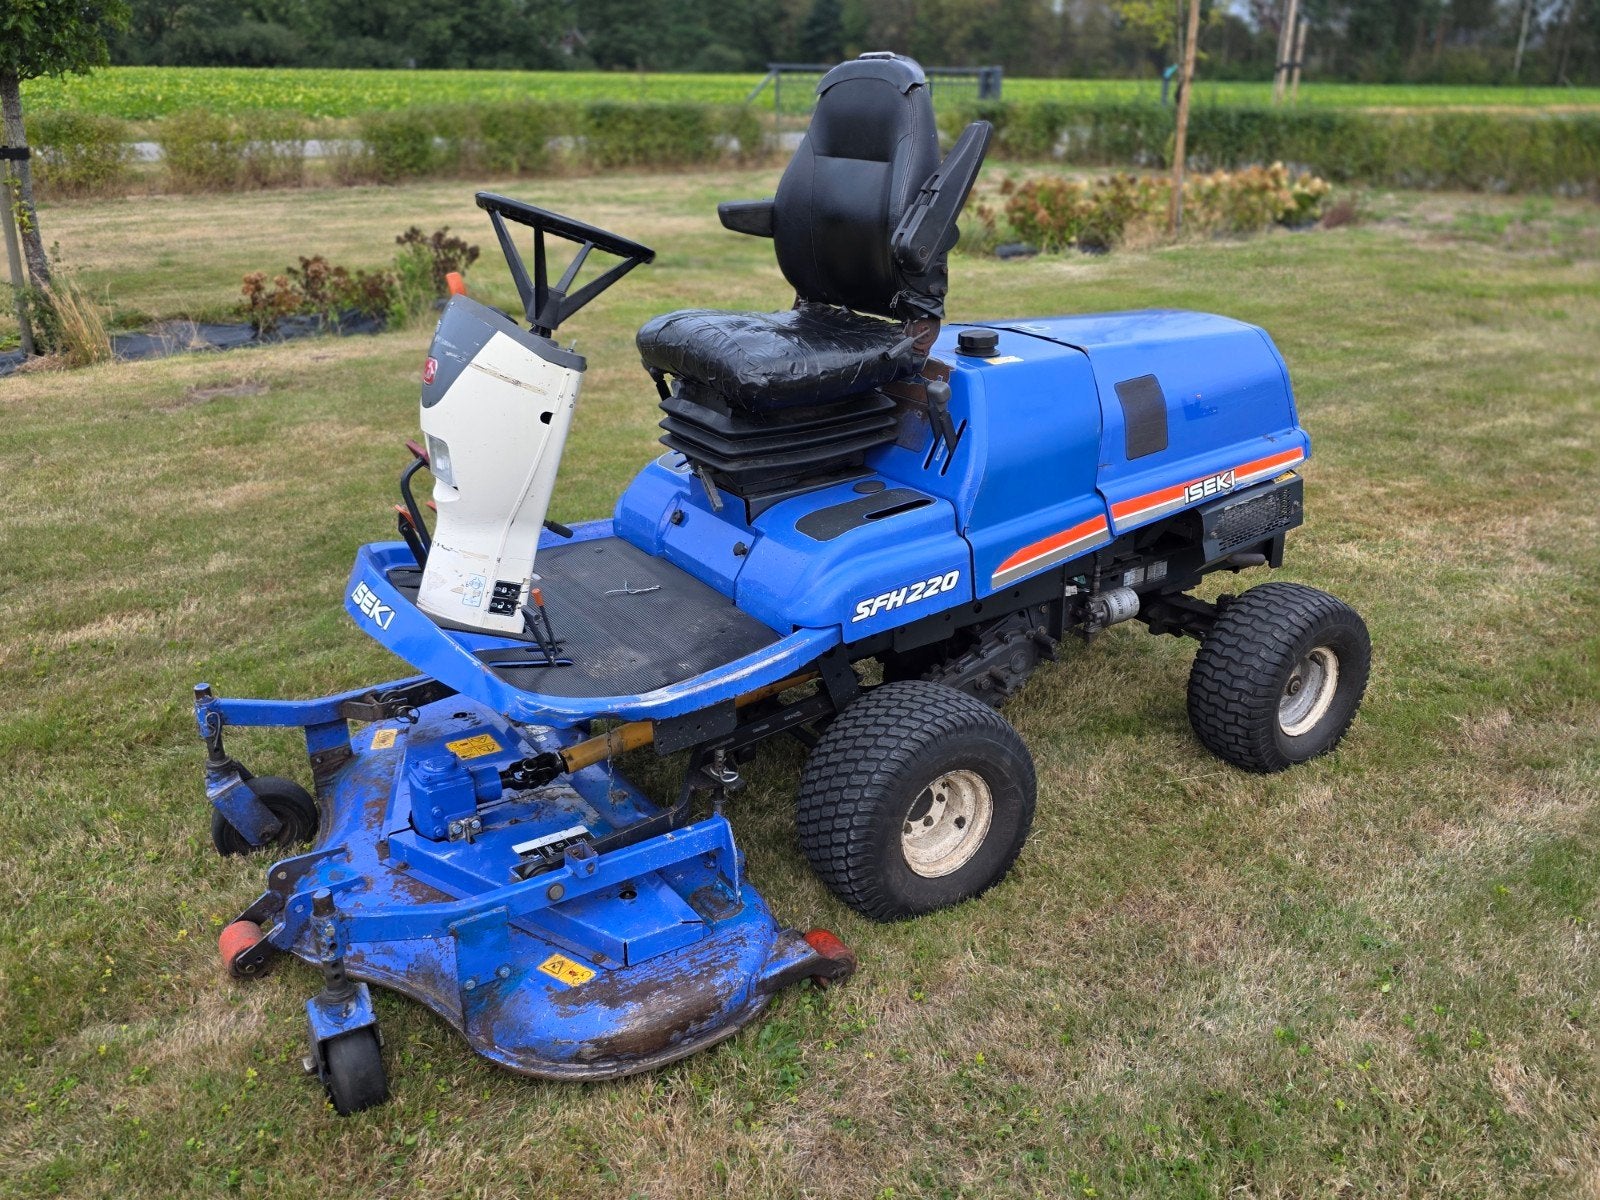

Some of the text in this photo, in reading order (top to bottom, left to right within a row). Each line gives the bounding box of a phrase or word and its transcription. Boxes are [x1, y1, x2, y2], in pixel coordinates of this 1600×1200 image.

[1184, 469, 1236, 504] ISEKI
[351, 580, 396, 631] ISEKI
[851, 570, 960, 623] SFH220
